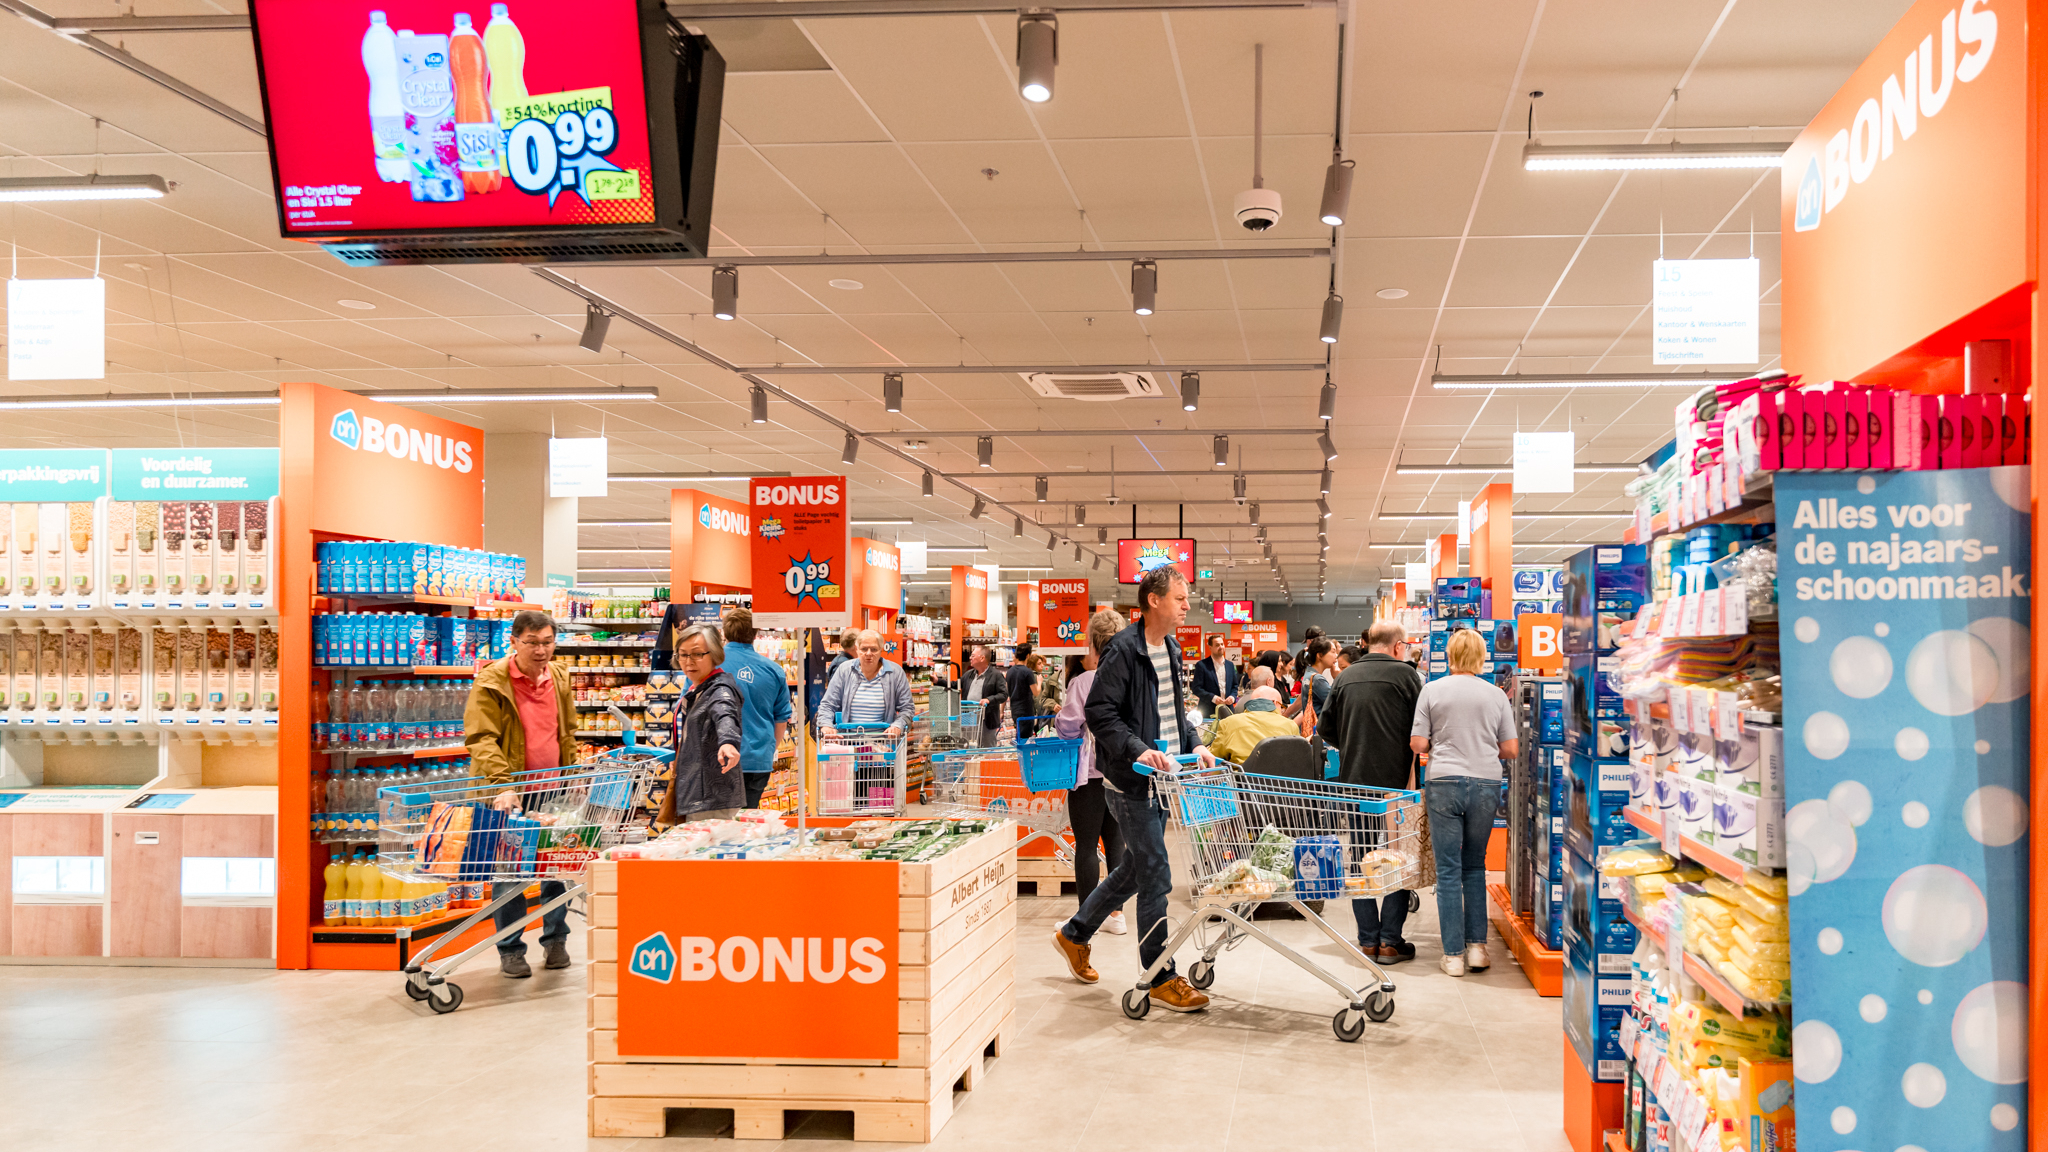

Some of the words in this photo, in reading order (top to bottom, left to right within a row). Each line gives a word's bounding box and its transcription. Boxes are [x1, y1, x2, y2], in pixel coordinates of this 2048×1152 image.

[402, 76, 450, 96] Crystal
[408, 92, 443, 107] Clear
[1825, 0, 1997, 213] BONUS
[462, 130, 493, 156] Sisi
[286, 186, 303, 196] Alle
[304, 184, 337, 197] Crystal
[337, 184, 362, 195] Clear
[287, 199, 300, 207] en
[300, 197, 317, 207] Sisi
[319, 196, 333, 206] 1.5
[333, 196, 353, 206] liter
[1659, 266, 1682, 282] 15
[1690, 320, 1696, 328] &
[1698, 320, 1747, 328] Wenskaarten
[1658, 352, 1704, 360] Tijdschriften
[363, 416, 473, 473] BONUS
[141, 456, 212, 474] Voordelig
[141, 476, 160, 488] en
[163, 474, 249, 488] duurzamer.
[755, 485, 840, 505] BONUS
[711, 507, 750, 537] BONU
[1793, 498, 1878, 529] Alles
[1887, 502, 1972, 528] voor
[872, 550, 898, 571] BONUS
[1143, 548, 1169, 558] Mega
[1794, 533, 1837, 565] de
[1847, 533, 1998, 571] najaars-
[785, 562, 830, 596] 0.99
[969, 574, 986, 591] BONUS
[1795, 566, 2031, 600] schoonmaak.
[1041, 583, 1086, 594] BONUS
[1057, 622, 1081, 640] 0.99
[547, 852, 594, 860] TSINGTAO
[951, 873, 979, 908] Albert
[983, 861, 1005, 888] Heijn
[965, 906, 980, 930] Sinds
[680, 936, 887, 984] BONUS
[1602, 988, 1632, 996] PHILIP
[1702, 1022, 1720, 1033] Dettol
